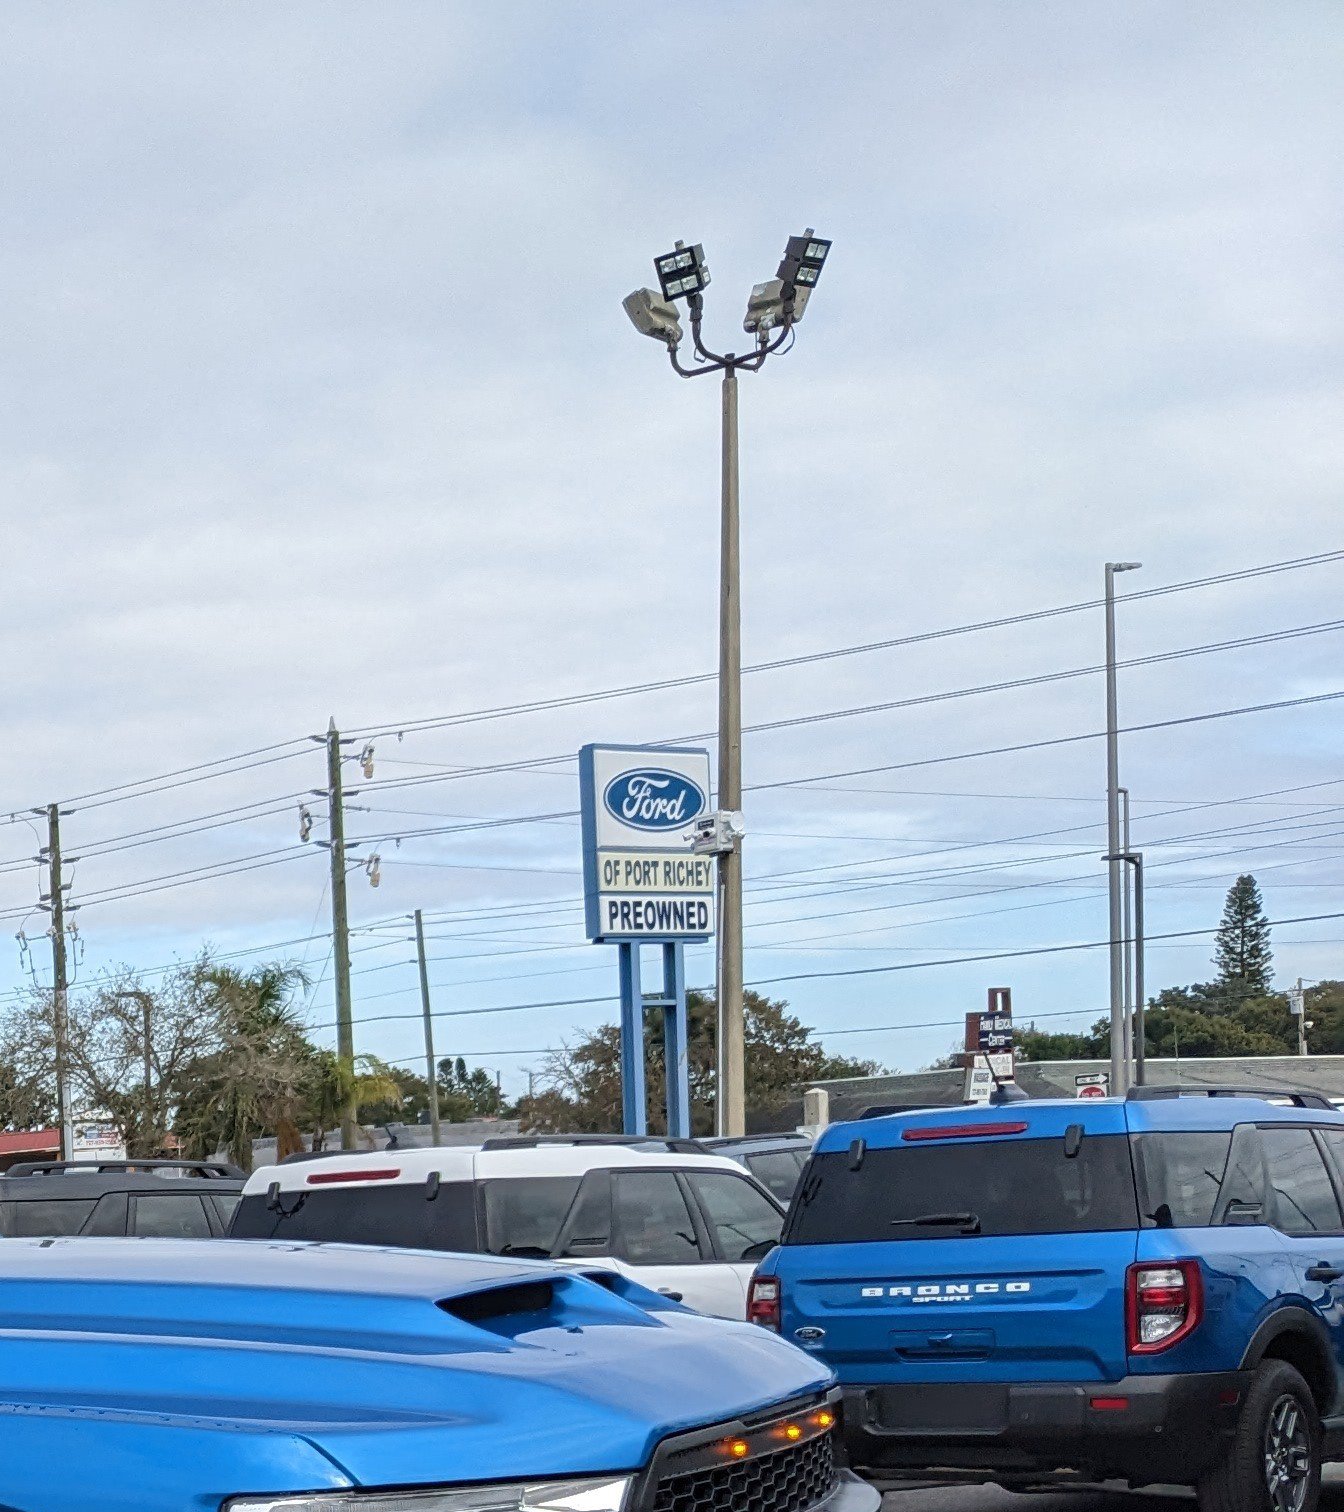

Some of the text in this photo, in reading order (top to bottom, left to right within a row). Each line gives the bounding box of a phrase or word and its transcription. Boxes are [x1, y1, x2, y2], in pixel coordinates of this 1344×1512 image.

[622, 777, 685, 820] Ford
[604, 859, 711, 887] OF PORT RICHEY
[609, 901, 708, 929] PREOWNED
[862, 1282, 1030, 1297] BRONCO
